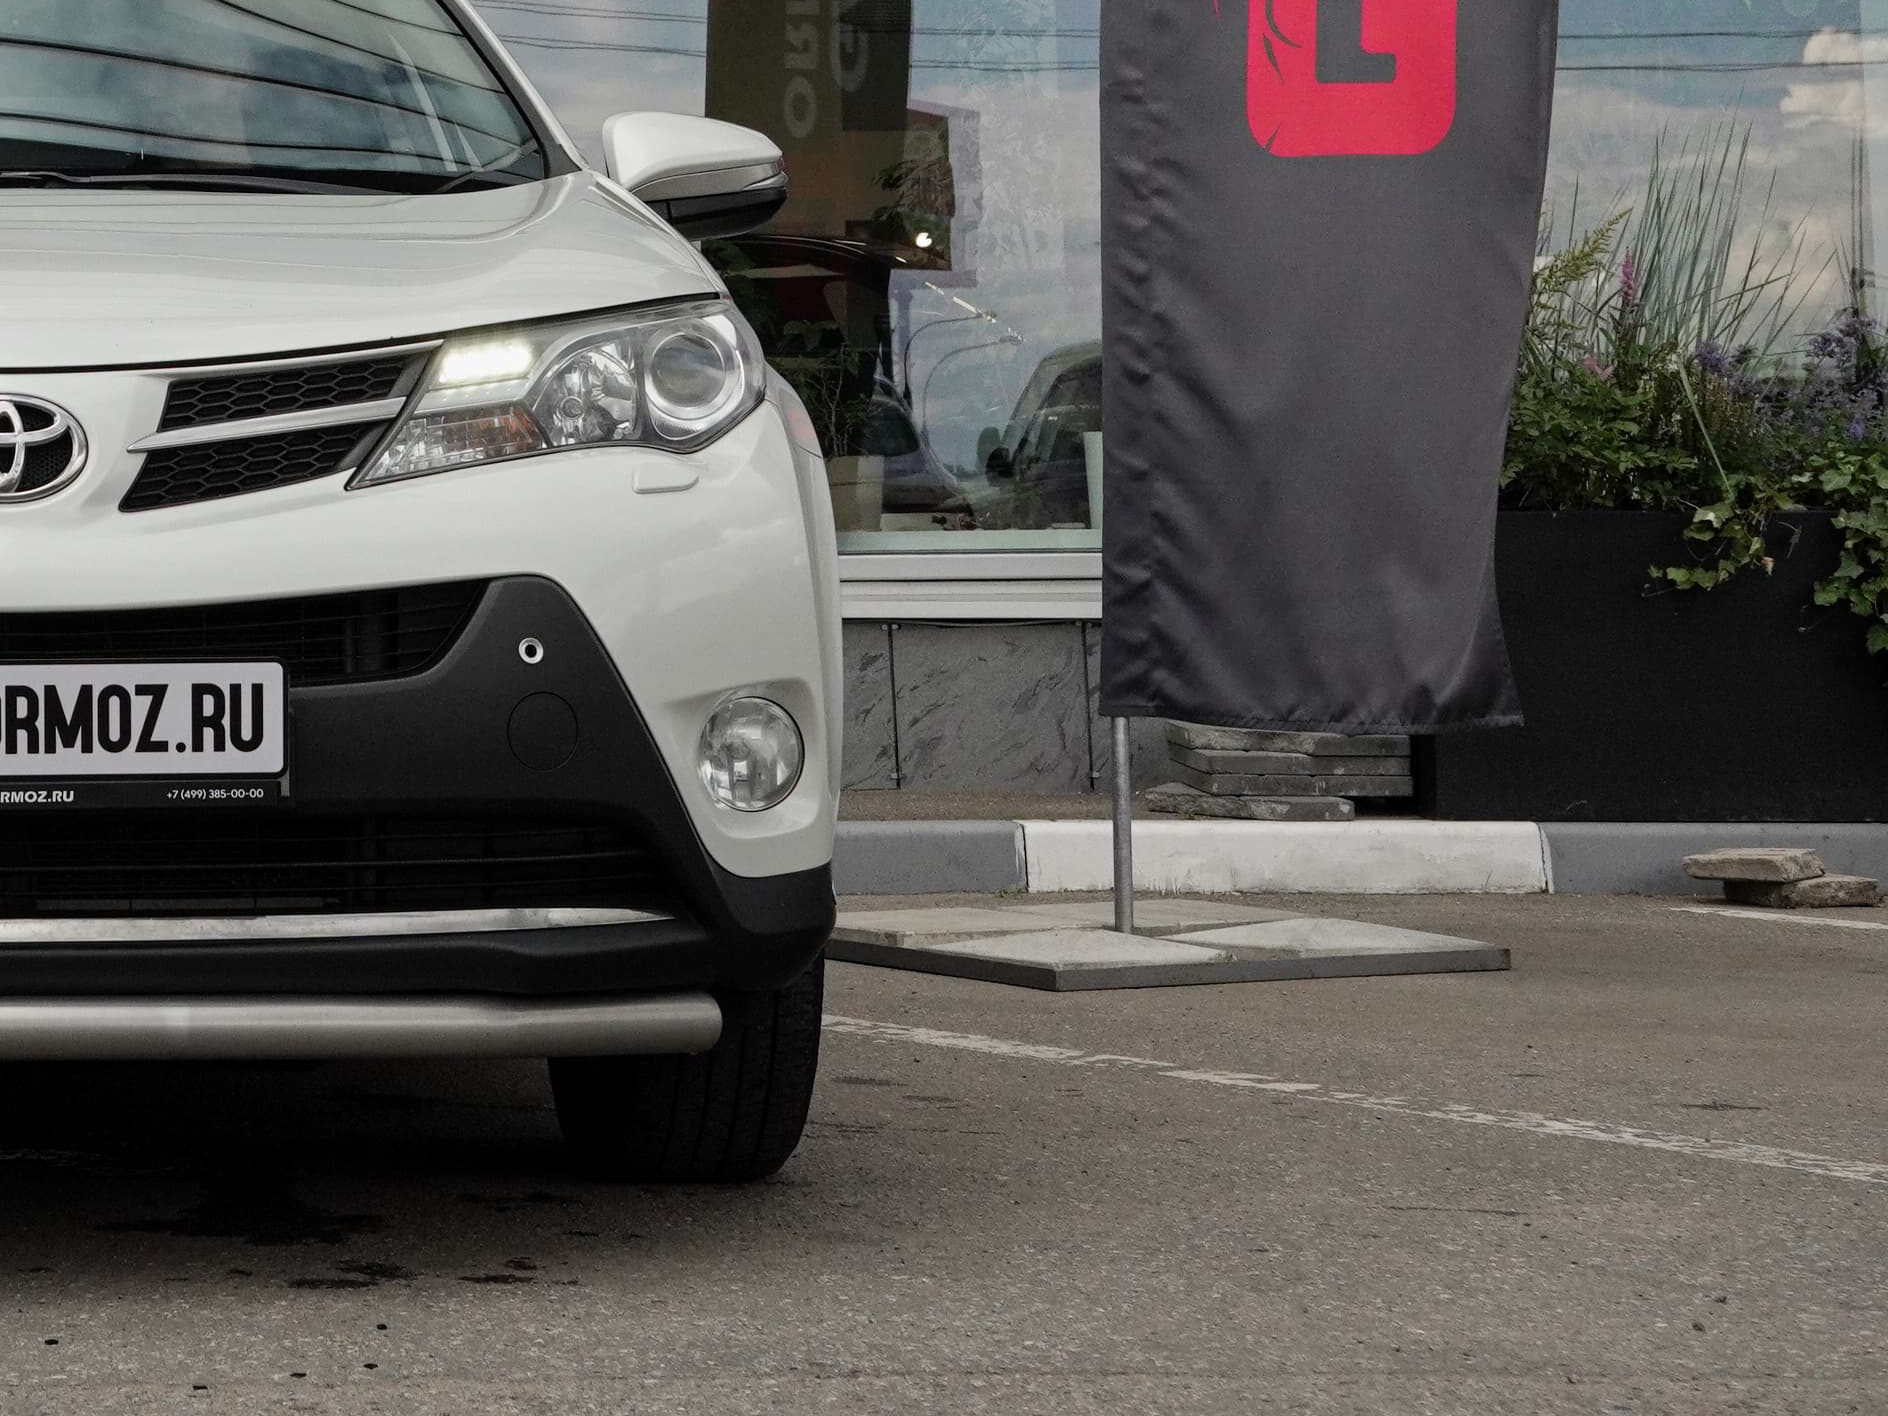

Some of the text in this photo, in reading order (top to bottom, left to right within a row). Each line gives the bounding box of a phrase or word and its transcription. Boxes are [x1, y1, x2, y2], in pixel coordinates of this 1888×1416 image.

[166, 788, 264, 800] +7 (499) 385-00-00
